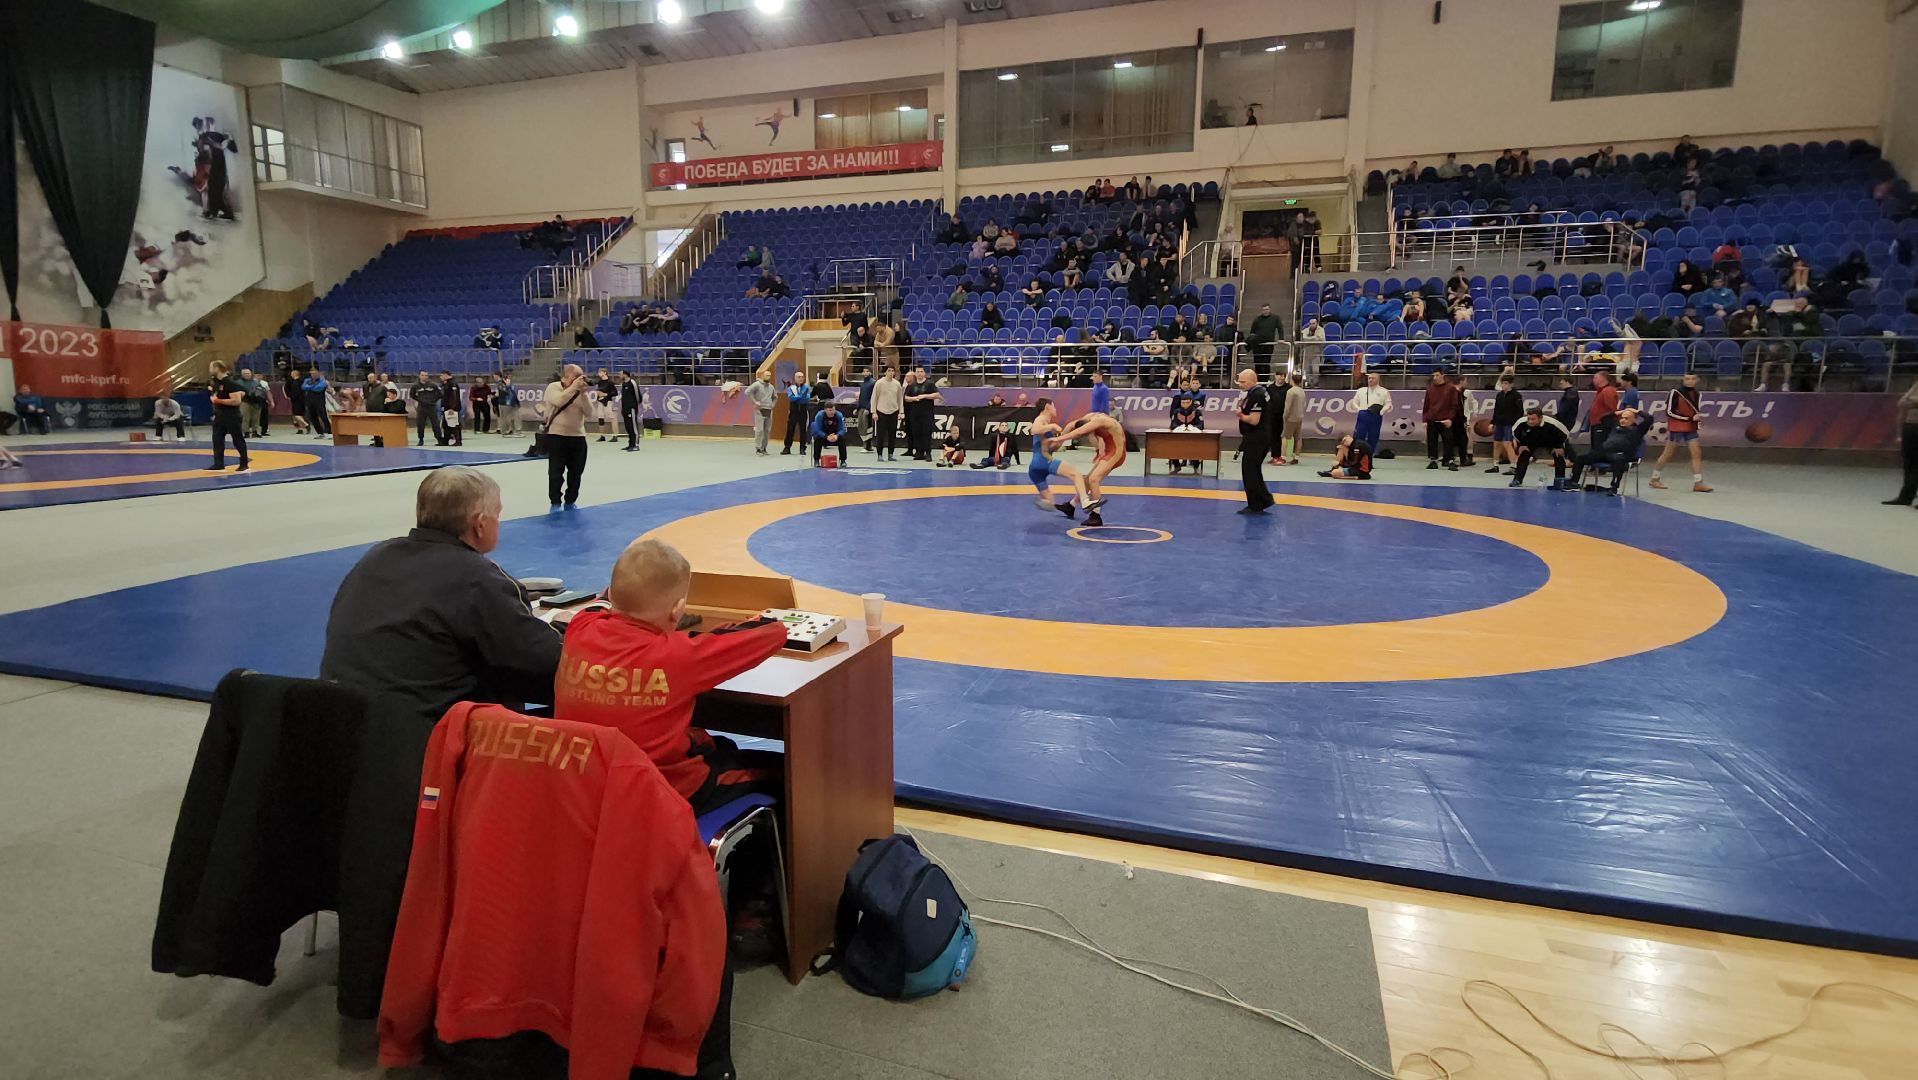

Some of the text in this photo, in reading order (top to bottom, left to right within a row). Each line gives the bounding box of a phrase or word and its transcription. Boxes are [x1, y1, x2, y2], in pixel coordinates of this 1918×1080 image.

[684, 149, 899, 179] ПОБЕДА БУДЕТ ЗА НАМИ!!!
[19, 327, 99, 357] 2023
[61, 373, 130, 387] mfc-kprf.ru
[622, 696, 667, 706] TEAM
